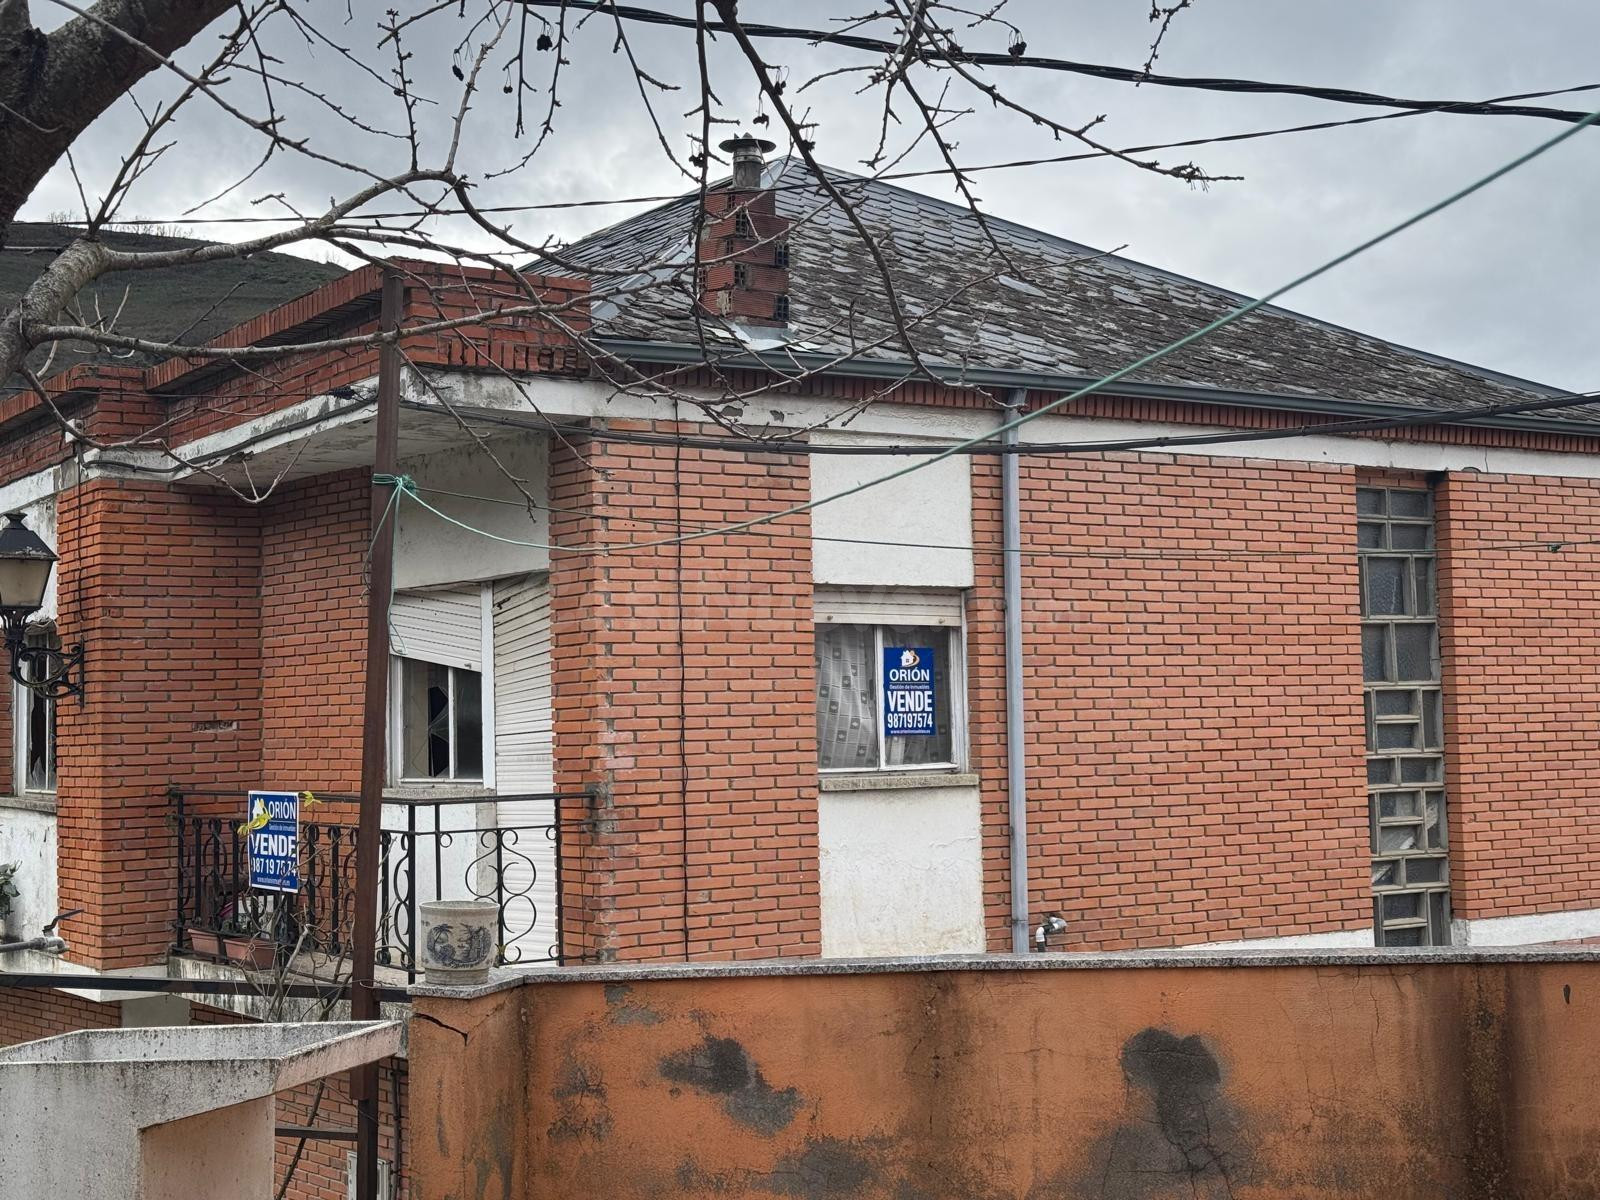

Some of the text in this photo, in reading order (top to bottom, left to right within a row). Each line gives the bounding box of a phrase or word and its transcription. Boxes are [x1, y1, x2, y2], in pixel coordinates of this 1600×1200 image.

[889, 667, 930, 682] ORIÓN
[887, 691, 933, 712] VENDE
[887, 713, 933, 728] 987197574
[268, 798, 296, 820] ORIÓN
[250, 833, 296, 858] VENDE
[265, 859, 275, 875] 19
